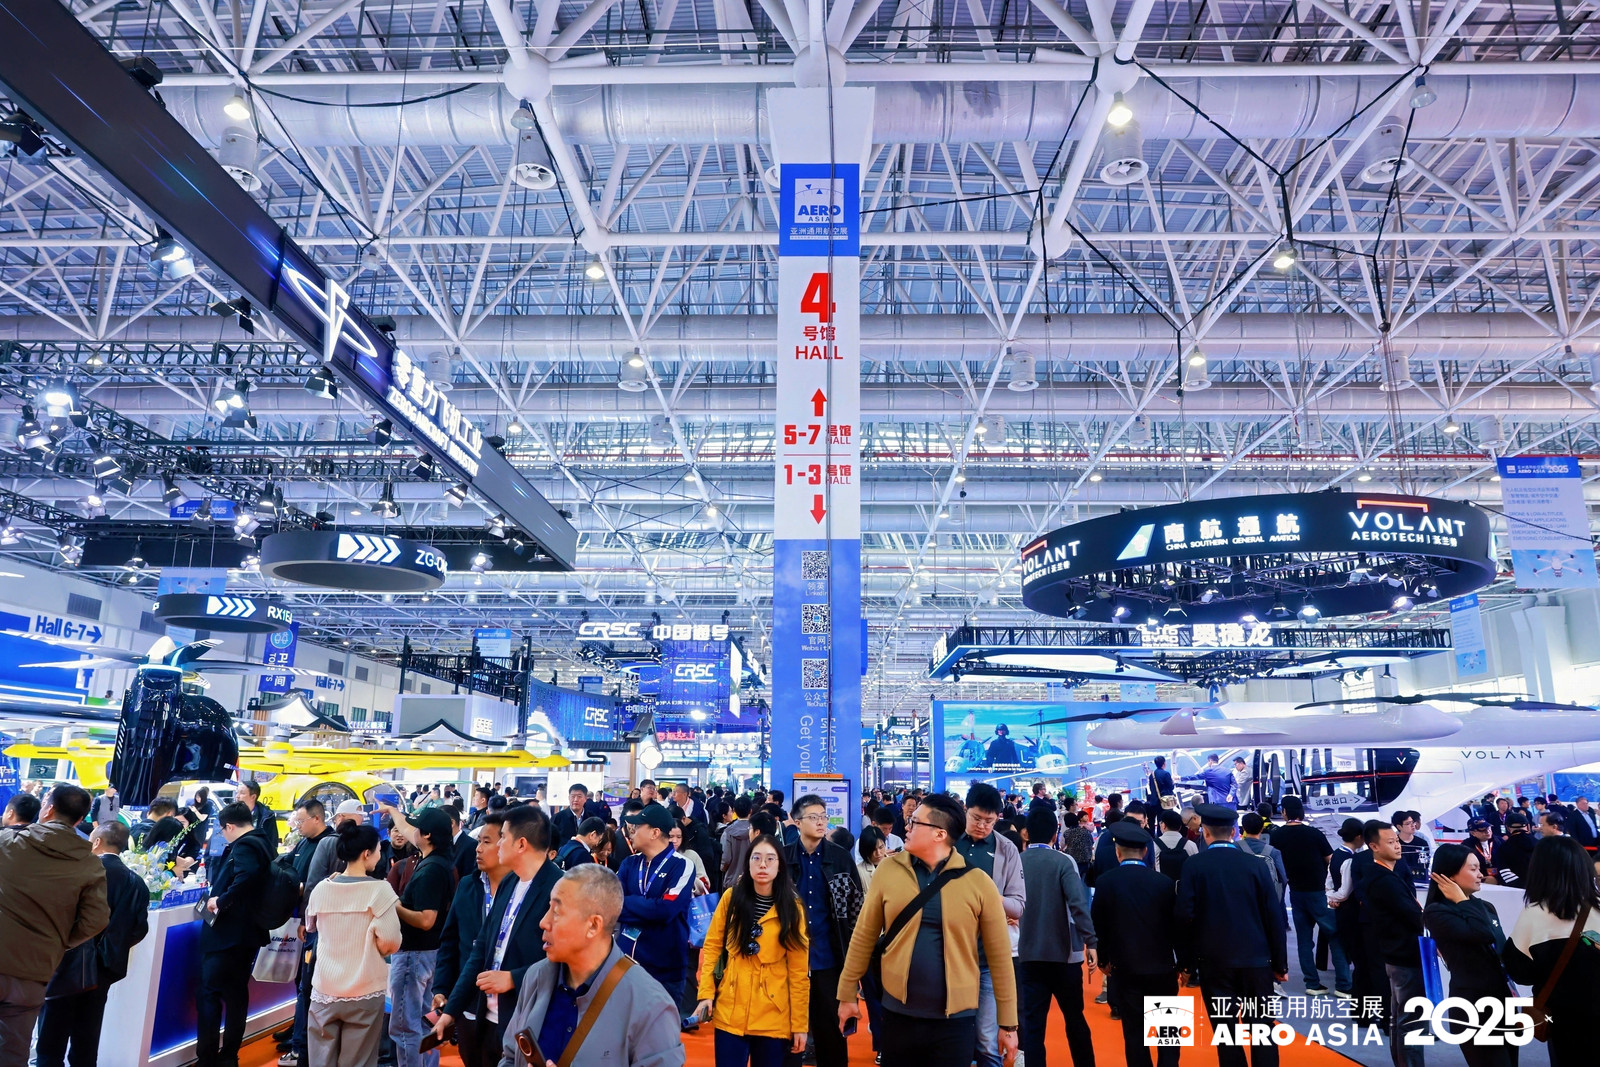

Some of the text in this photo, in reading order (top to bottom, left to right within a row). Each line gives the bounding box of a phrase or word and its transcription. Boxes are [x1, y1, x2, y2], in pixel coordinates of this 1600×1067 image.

[798, 205, 841, 216] AERO
[800, 272, 836, 323] 4
[803, 326, 836, 341] 号馆
[795, 345, 843, 359] HALL
[784, 424, 821, 445] 5-7
[784, 464, 821, 485] 1-3
[1348, 511, 1466, 537] VOLANT
[1166, 542, 1188, 551] CHINA
[1190, 538, 1229, 548] SOUTHERN
[1232, 536, 1265, 545] GENERAL
[1351, 531, 1424, 543] AEROTECH
[1023, 540, 1081, 576] VOLANT
[36, 615, 87, 640] Hall 6-7
[578, 622, 642, 640] CRSC
[652, 624, 729, 641] 中国通号
[808, 636, 826, 645] 官网
[674, 664, 716, 681] CRSC
[800, 715, 814, 740] Get
[1461, 750, 1545, 759] VOLANT
